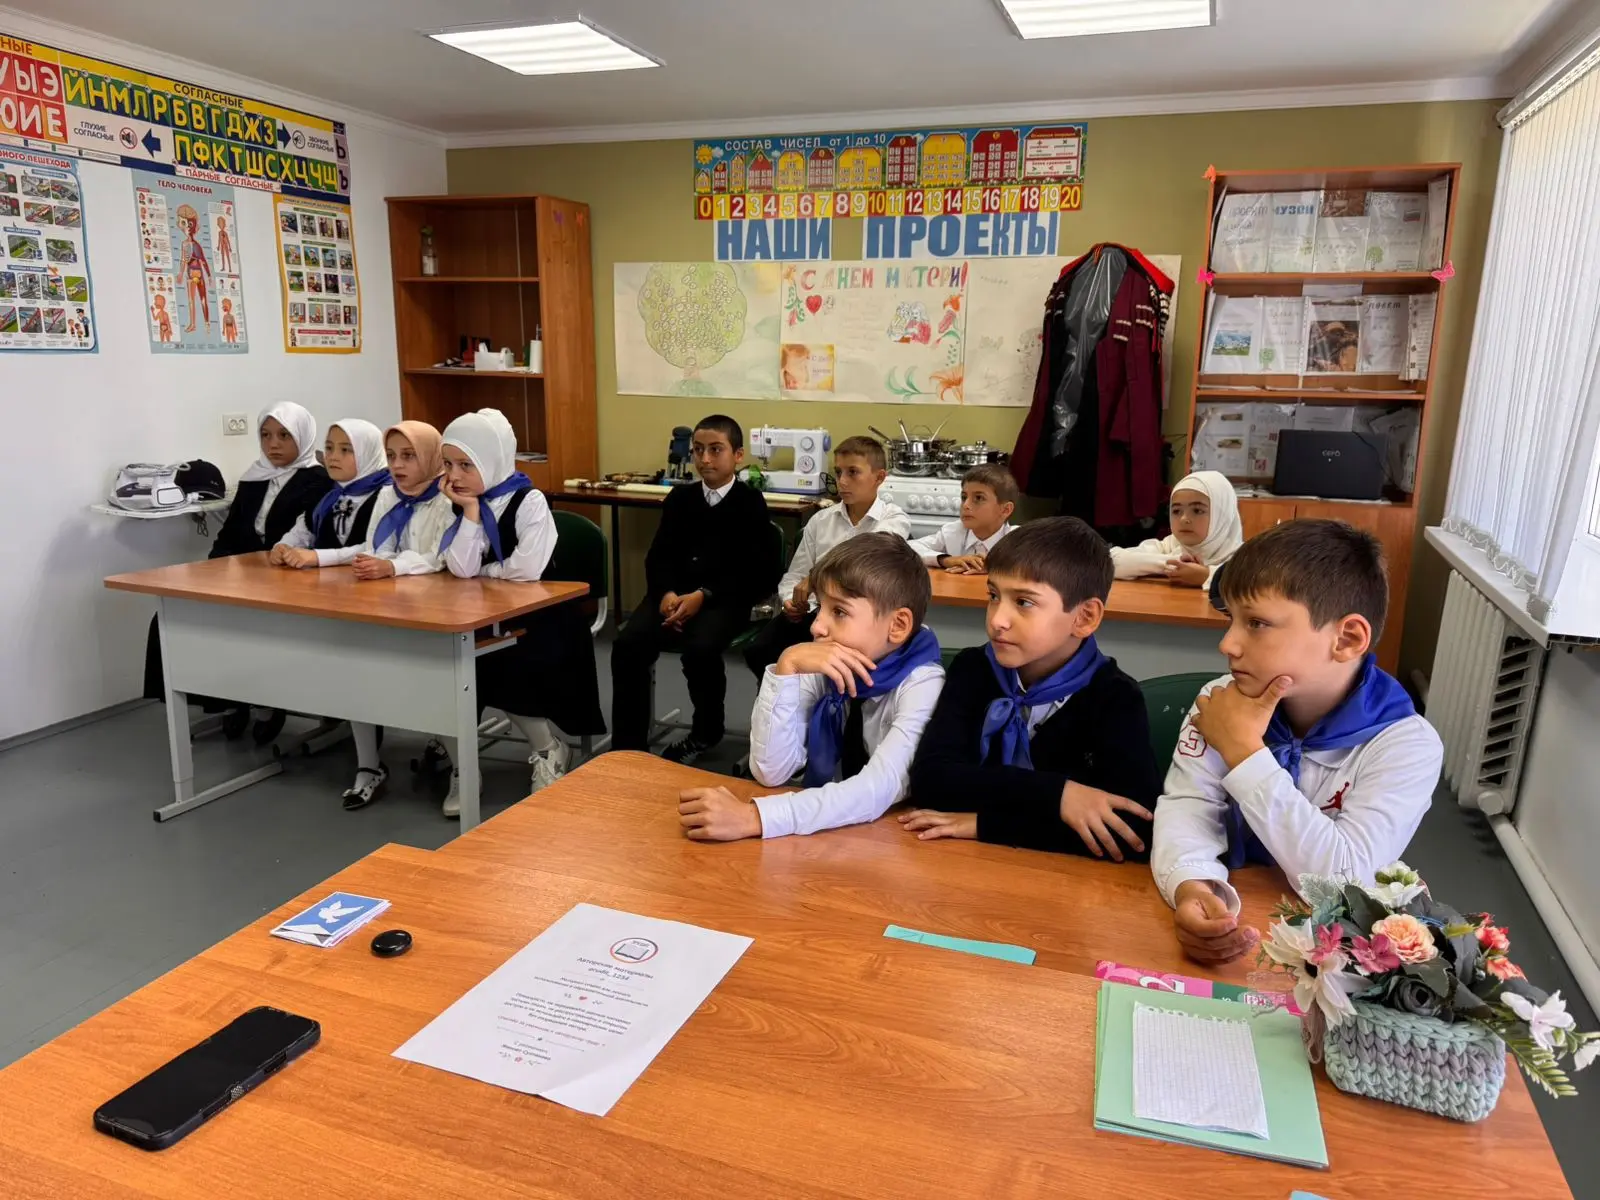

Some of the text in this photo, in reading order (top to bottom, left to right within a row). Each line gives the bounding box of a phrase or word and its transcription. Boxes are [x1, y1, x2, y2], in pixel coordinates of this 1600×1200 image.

[174, 83, 243, 108] СОГЛАСНЫЕ
[73, 128, 114, 141] СОГЛАСНЫЕ
[80, 121, 106, 133] ГЛУХИЕ
[725, 134, 886, 152] СОСТАВ ЧИСЕЛ от 1 до 10
[27, 154, 72, 168] ПЕШЕХОДА
[157, 180, 213, 194] ТЕЛО ЧЕЛОВЕКА
[185, 169, 274, 191] ПАРНЫЕ СОГЛАСНЫЕ
[700, 185, 1081, 217] 0 1 2 3 4 5 6 7 8 9 10 11 12 13 14 15 16 17 18 19 20
[718, 211, 1058, 260] НАШИ ПРОЕКТЫ
[801, 269, 817, 291] С
